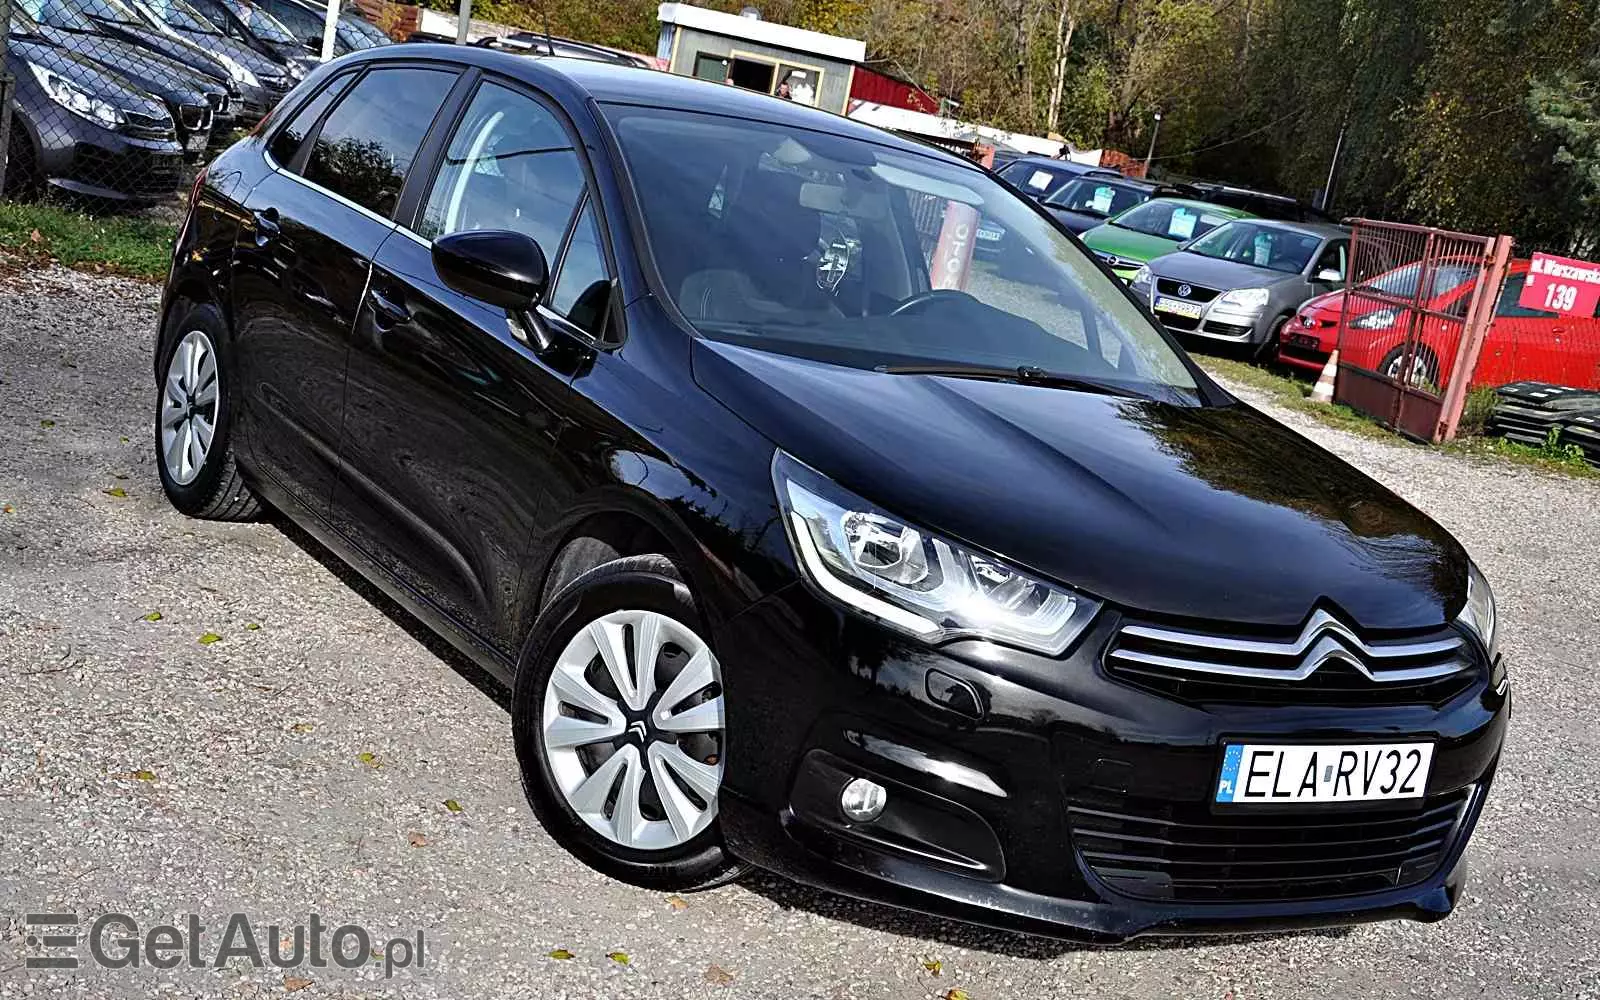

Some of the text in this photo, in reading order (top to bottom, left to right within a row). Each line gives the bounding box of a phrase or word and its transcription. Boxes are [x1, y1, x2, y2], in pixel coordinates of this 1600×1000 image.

[1544, 283, 1577, 311] 139
[1217, 780, 1233, 795] PL
[1244, 749, 1422, 798] ELA RV32
